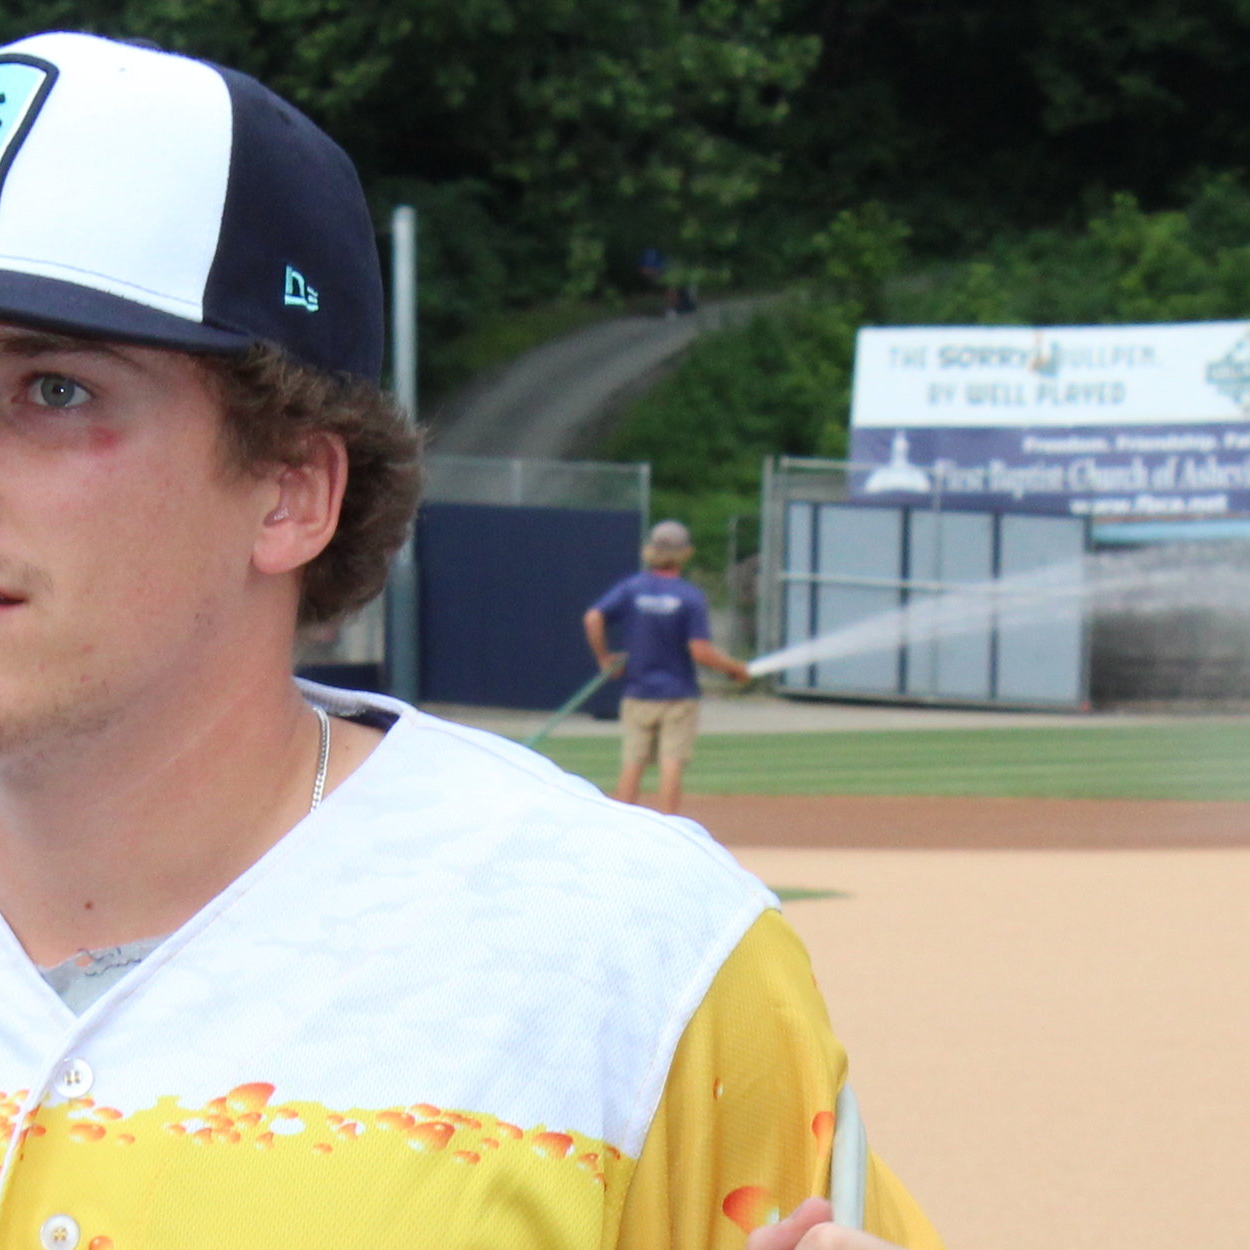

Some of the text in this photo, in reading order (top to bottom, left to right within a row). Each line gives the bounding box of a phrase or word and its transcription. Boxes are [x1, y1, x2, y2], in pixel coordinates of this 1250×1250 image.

[937, 344, 1029, 370] SORRY
[928, 380, 1126, 407] BY WELL PLAYED
[1068, 456, 1149, 491] Church
[1151, 455, 1178, 490] of
